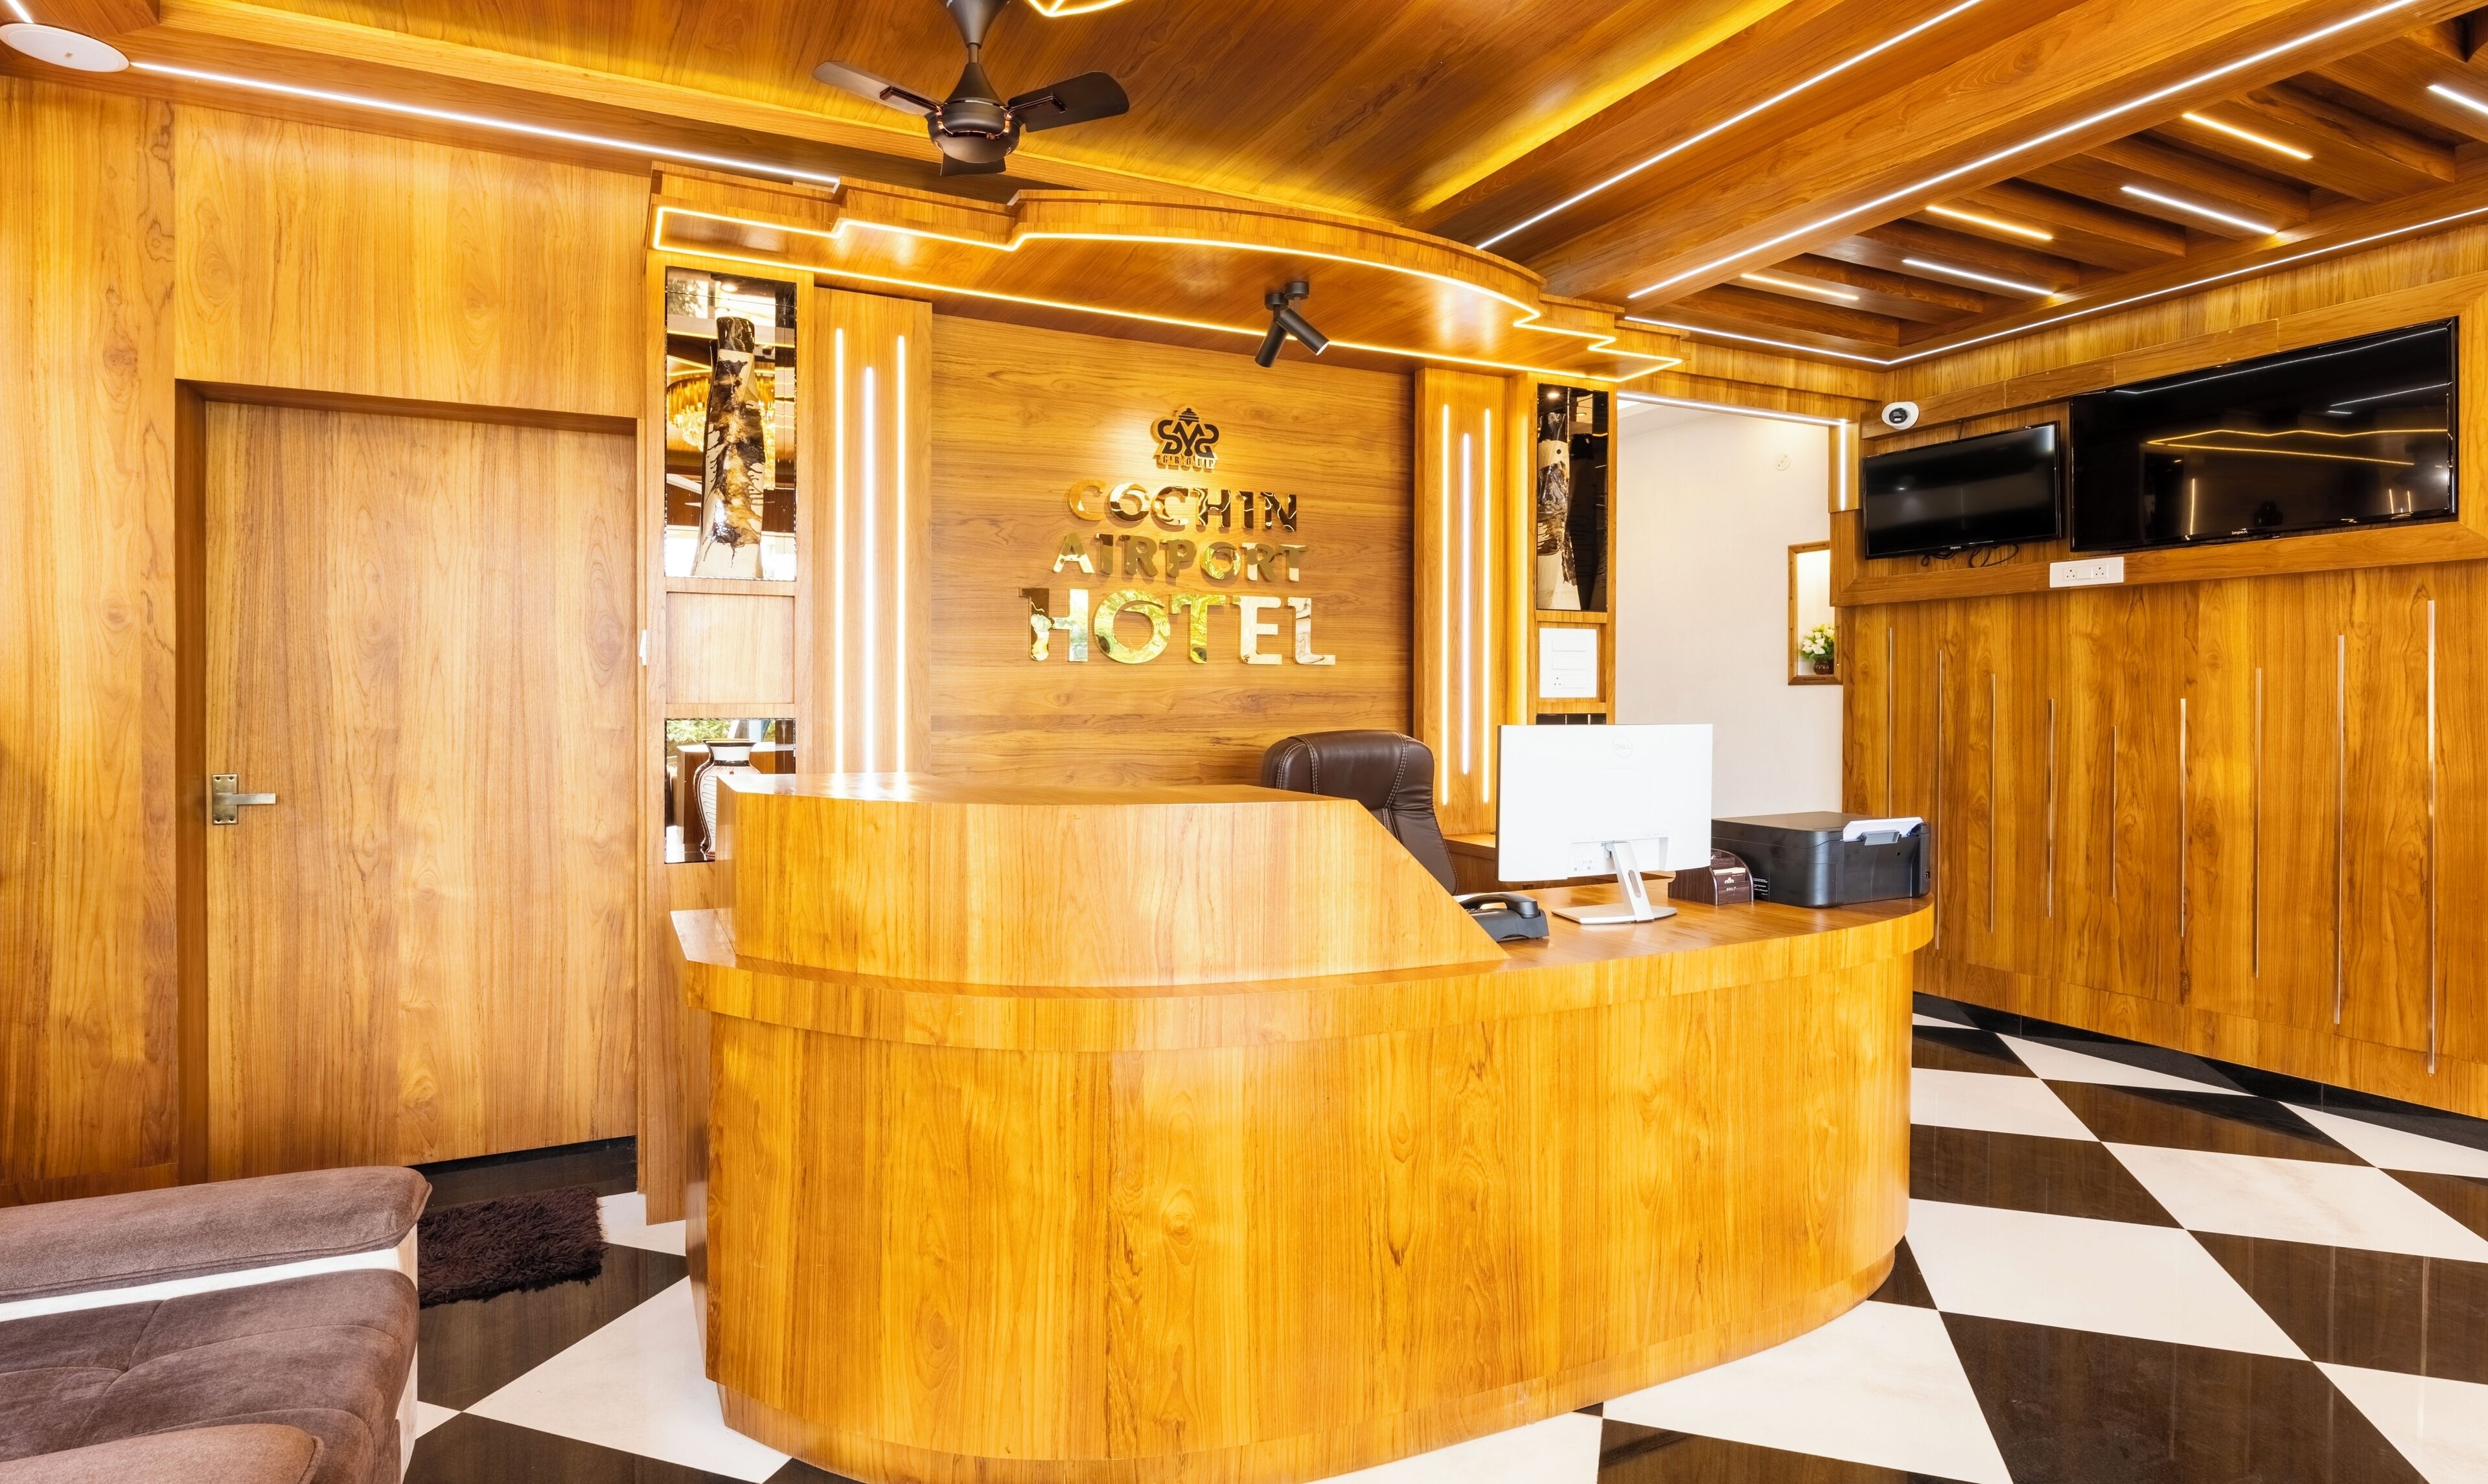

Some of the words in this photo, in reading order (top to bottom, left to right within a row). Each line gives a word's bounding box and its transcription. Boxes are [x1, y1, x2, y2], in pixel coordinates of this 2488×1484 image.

[1162, 455, 1214, 467] GROUP
[1067, 479, 1297, 532] COCHIN
[1052, 532, 1309, 582] AIRPORT
[1018, 587, 1336, 665] HOTEL
